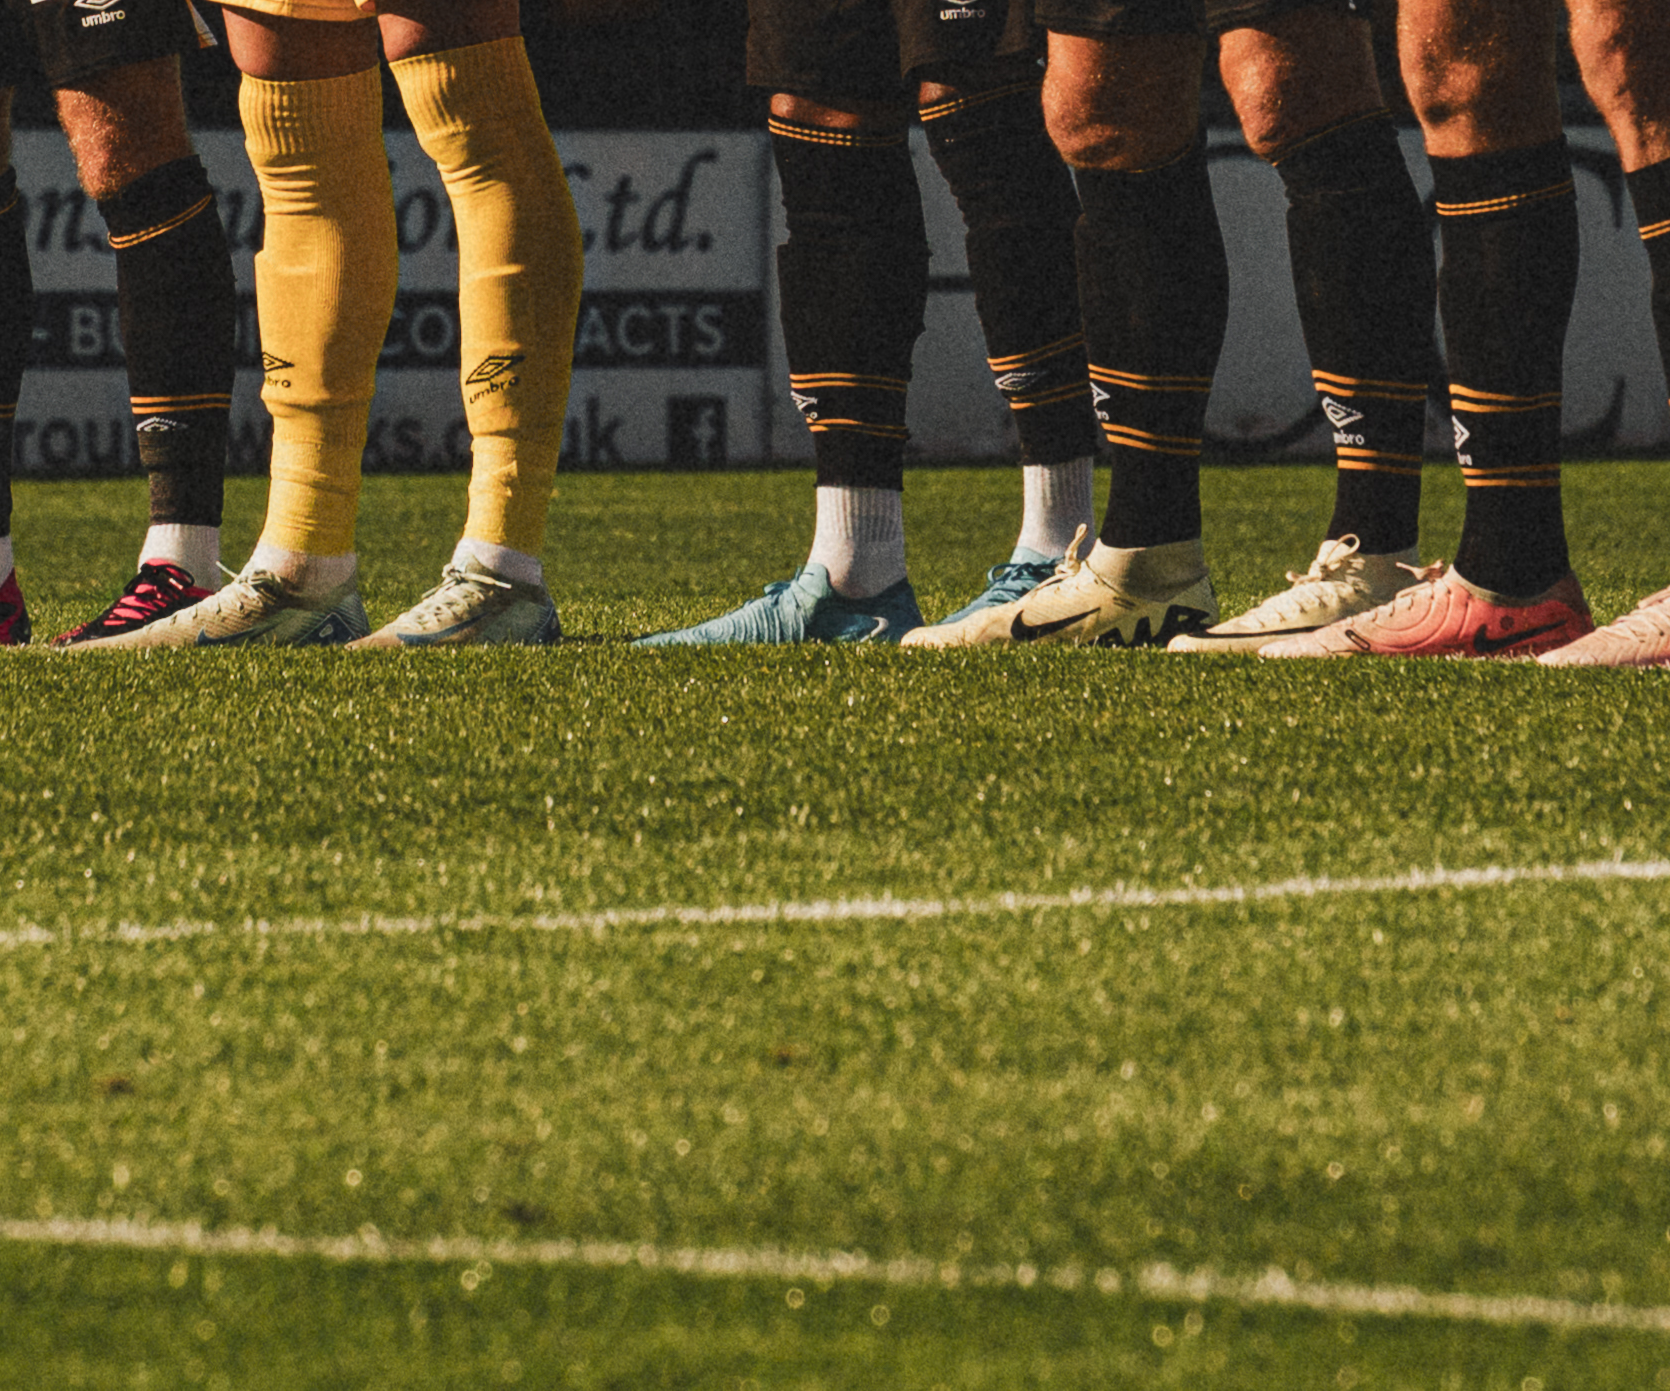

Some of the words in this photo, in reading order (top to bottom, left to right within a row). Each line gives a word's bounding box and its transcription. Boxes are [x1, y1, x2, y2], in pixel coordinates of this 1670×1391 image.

[79, 7, 127, 28] umbro
[941, 0, 986, 17] umbro
[468, 375, 520, 405] umbro
